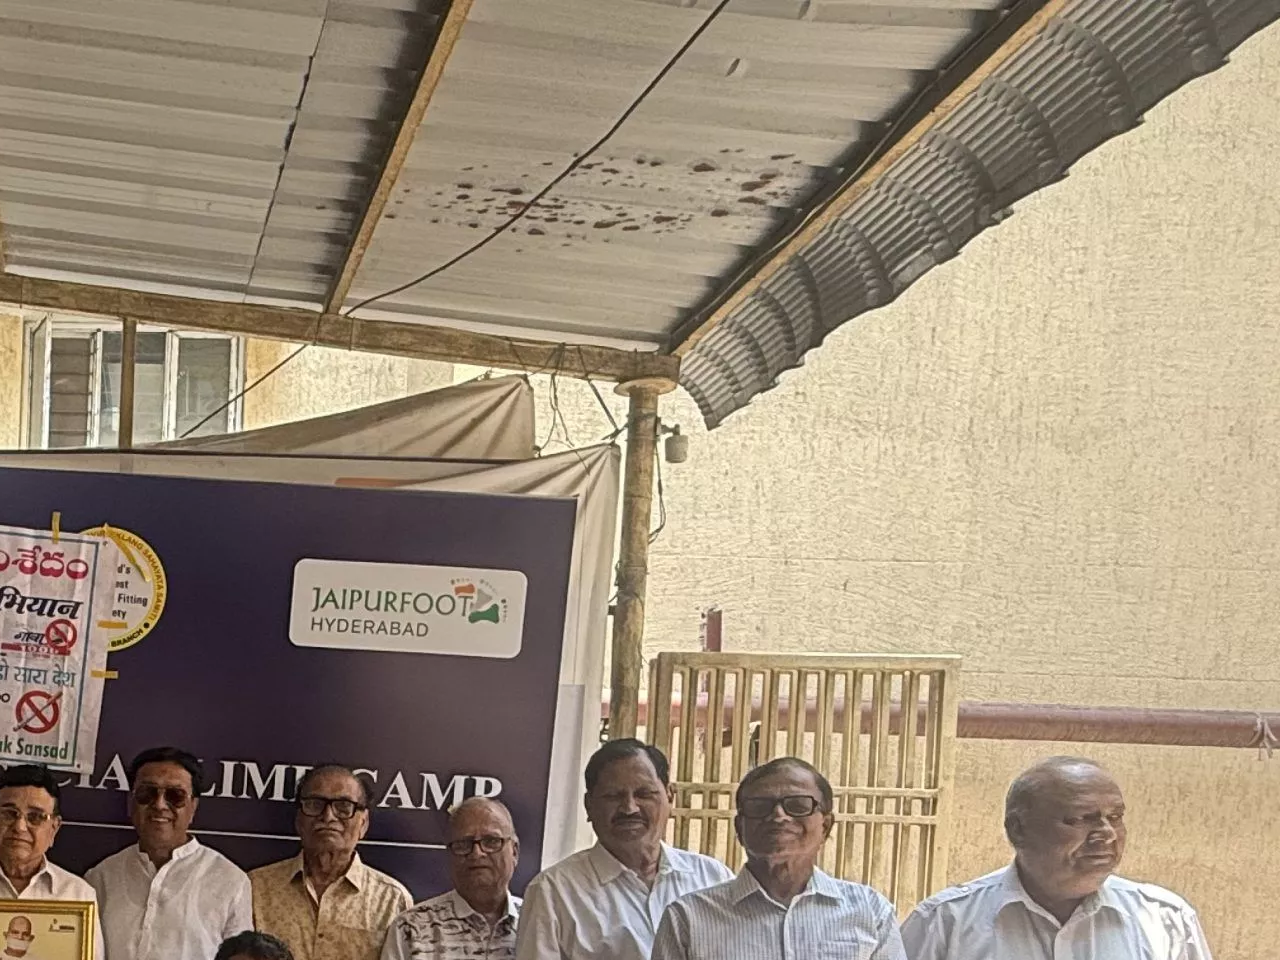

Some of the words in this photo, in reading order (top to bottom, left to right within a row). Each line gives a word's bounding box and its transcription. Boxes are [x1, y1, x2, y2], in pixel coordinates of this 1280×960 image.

[117, 593, 148, 608] Fitting
[311, 586, 474, 616] JAIPURFOOT
[310, 617, 429, 638] HYDERABAD
[14, 666, 48, 685] सारा
[52, 663, 76, 687] देश
[16, 738, 69, 759] Sansad
